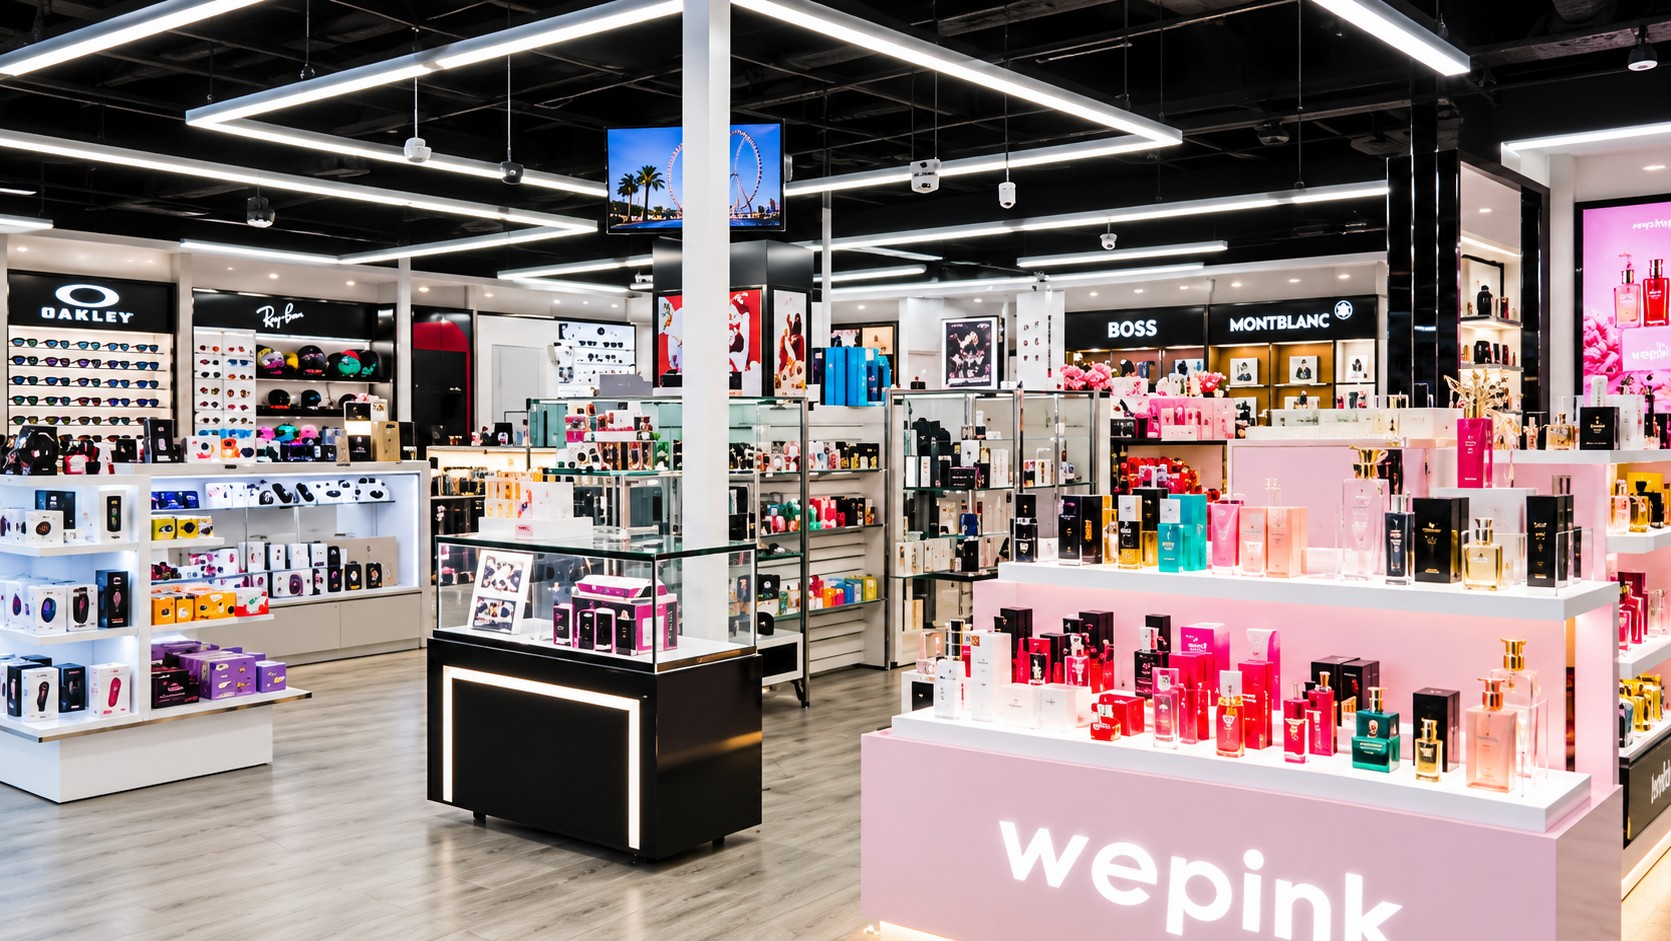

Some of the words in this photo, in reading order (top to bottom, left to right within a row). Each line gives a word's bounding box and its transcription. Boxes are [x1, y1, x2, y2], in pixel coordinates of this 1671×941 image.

[41, 306, 134, 324] OAKLEY
[256, 302, 304, 329] Ray-Ban
[1229, 313, 1330, 332] MONTBLANC
[1107, 319, 1158, 338] BOSS
[998, 819, 1403, 941] wepink
